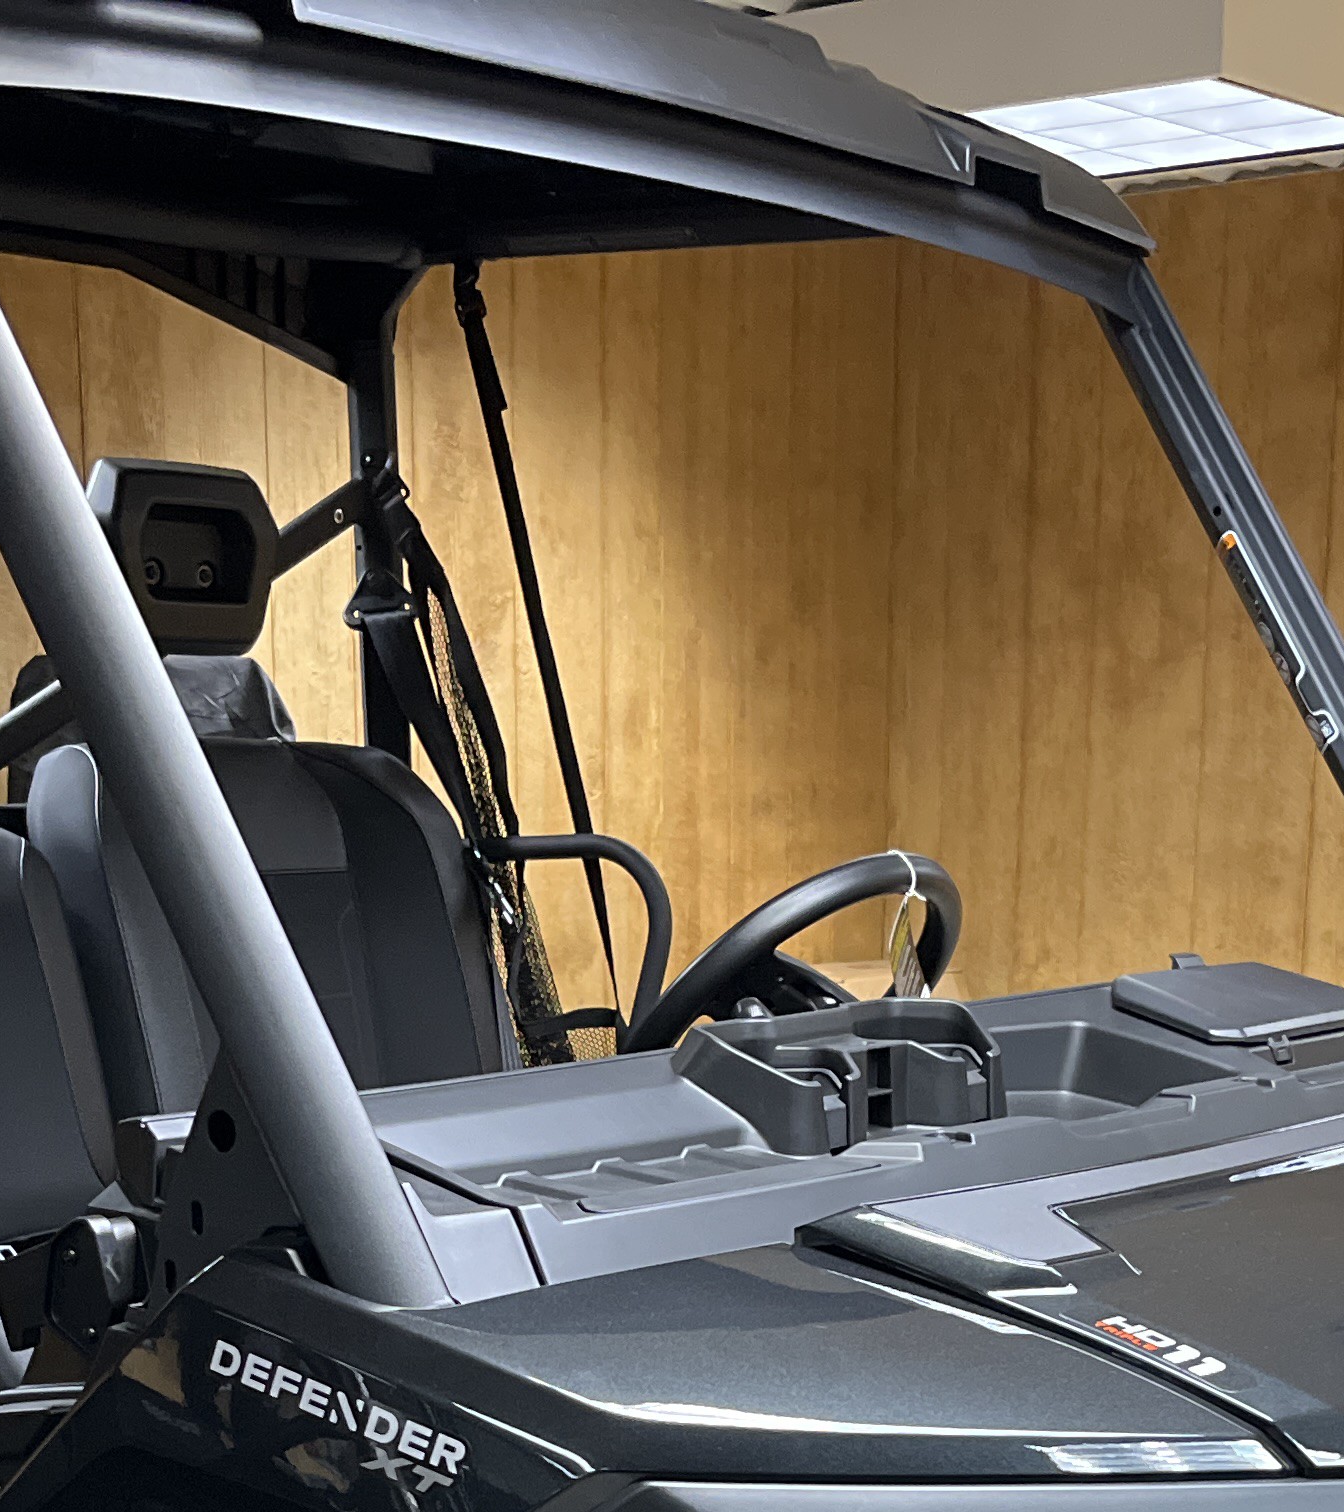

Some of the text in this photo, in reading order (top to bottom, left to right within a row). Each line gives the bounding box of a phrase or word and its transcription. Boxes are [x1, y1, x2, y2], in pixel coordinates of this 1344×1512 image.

[1101, 1315, 1227, 1377] HD11
[209, 1338, 467, 1475] DEFENDER
[359, 1445, 454, 1494] XT
